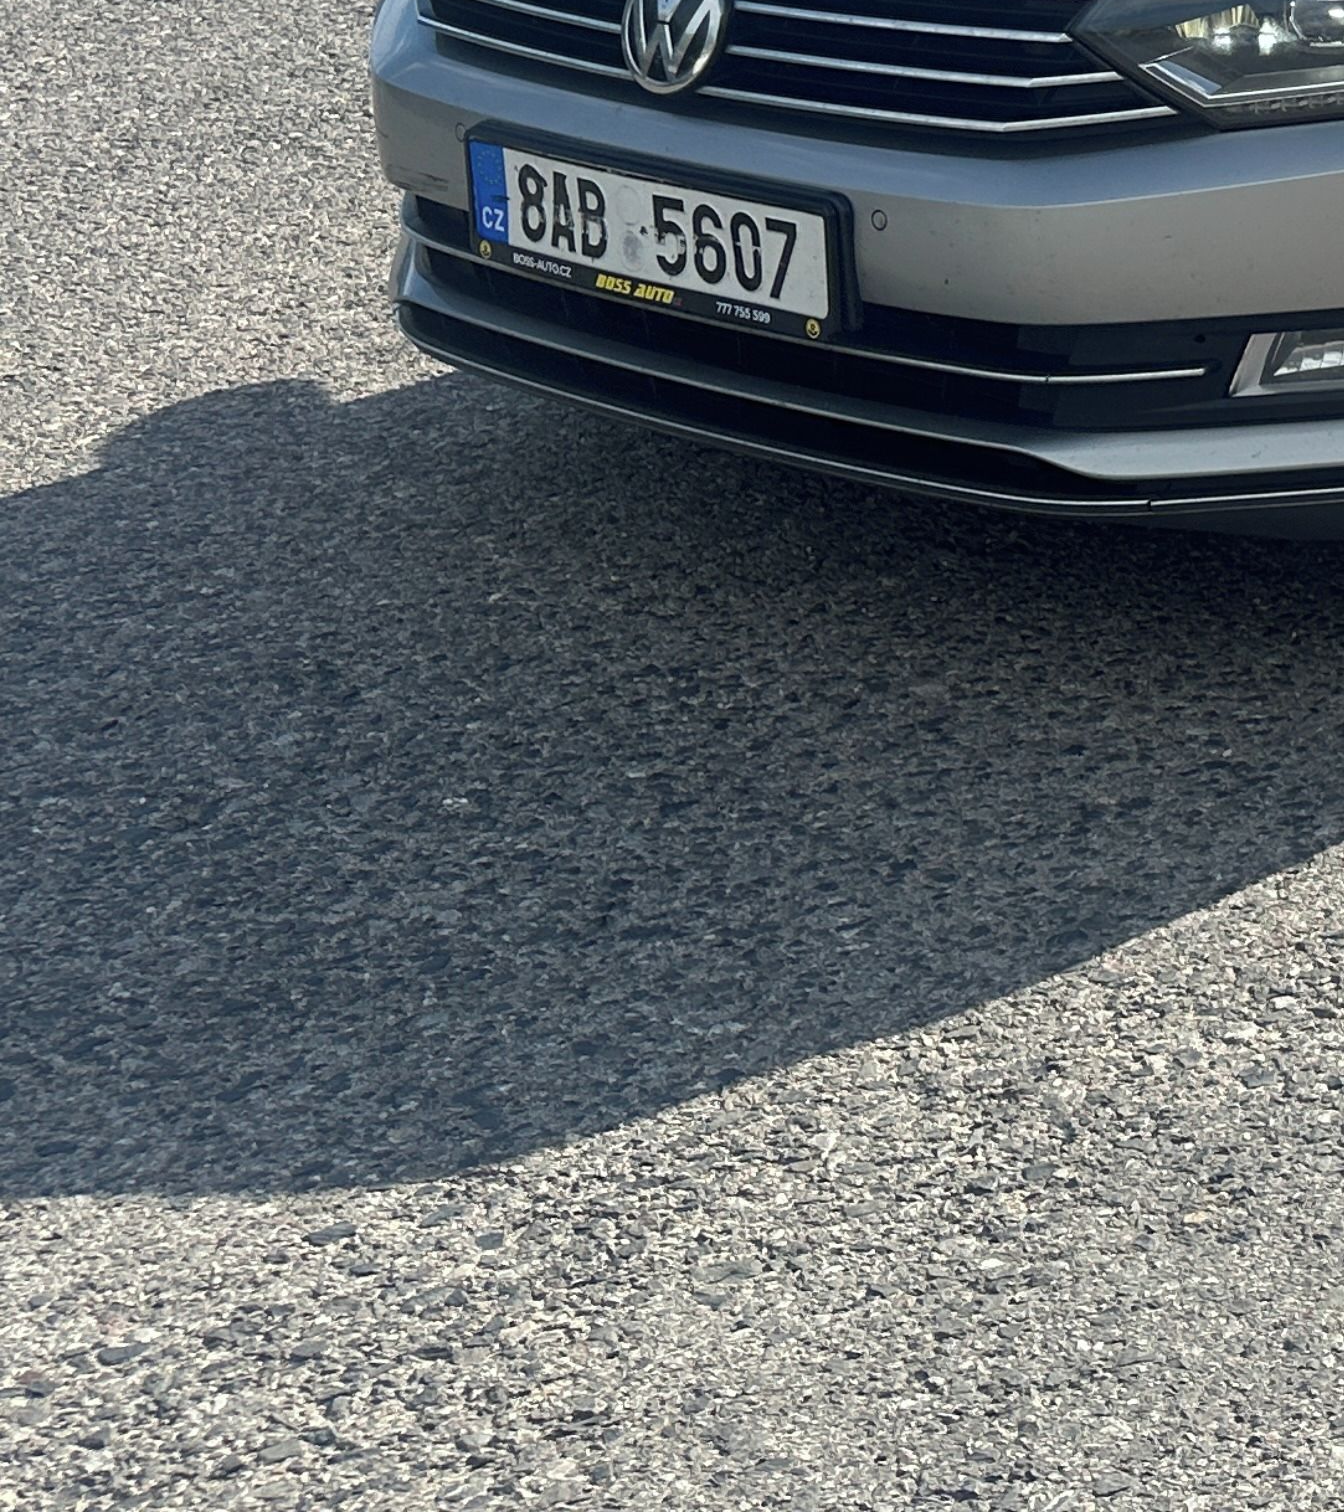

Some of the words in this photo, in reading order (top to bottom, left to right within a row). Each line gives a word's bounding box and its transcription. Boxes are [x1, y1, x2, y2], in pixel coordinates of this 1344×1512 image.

[482, 206, 505, 232] CZ
[518, 163, 608, 259] 8AB
[651, 194, 797, 300] 5607
[512, 252, 572, 278] BOSS-AUTO.CZ
[596, 273, 632, 294] BOSS
[633, 283, 676, 305] AUTO
